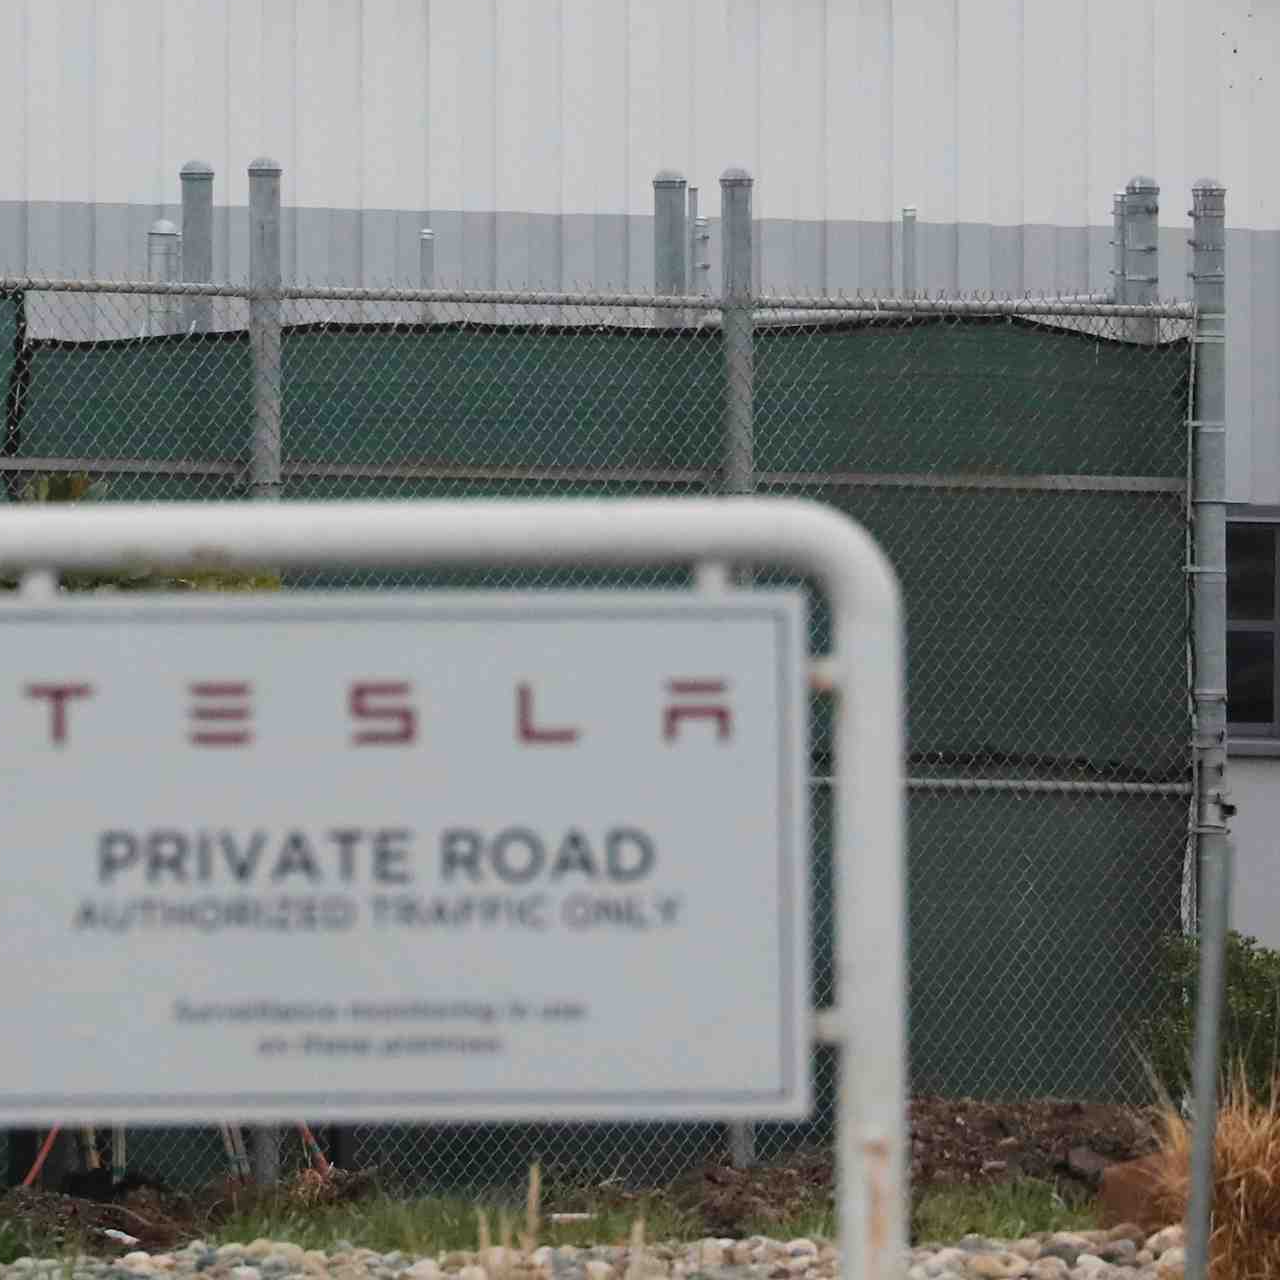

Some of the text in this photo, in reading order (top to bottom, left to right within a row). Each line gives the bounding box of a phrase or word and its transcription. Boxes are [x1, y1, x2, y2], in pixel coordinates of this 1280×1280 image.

[22, 676, 738, 749] TESLA
[97, 828, 657, 883] PRIVATE ROAD
[74, 896, 683, 932] AUTHORIZED TRAFFIC ONLY
